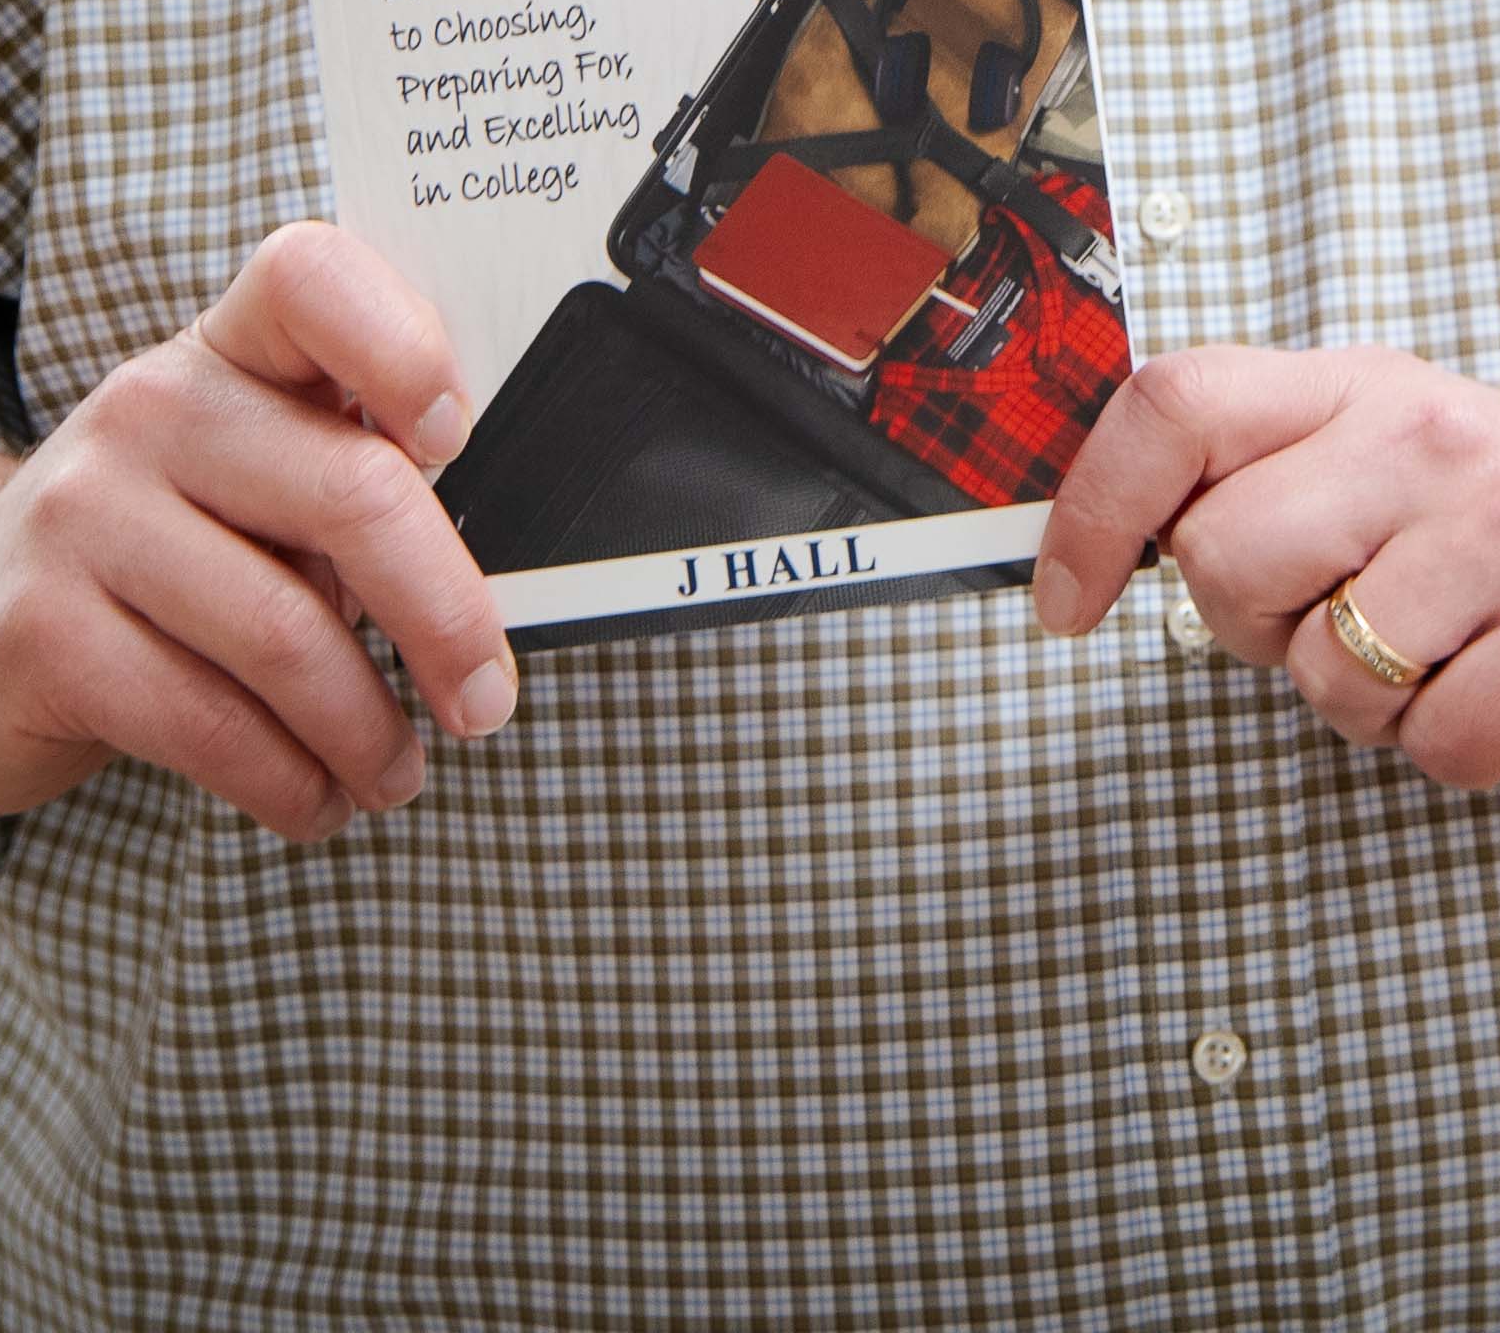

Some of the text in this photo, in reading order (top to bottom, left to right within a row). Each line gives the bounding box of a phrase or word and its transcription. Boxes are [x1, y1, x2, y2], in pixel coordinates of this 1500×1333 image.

[390, 0, 597, 51] to Choosing,
[396, 50, 634, 112] Preparing For,
[407, 98, 640, 155] and Excelling
[411, 161, 580, 207] in College
[678, 533, 877, 597] J HALL
